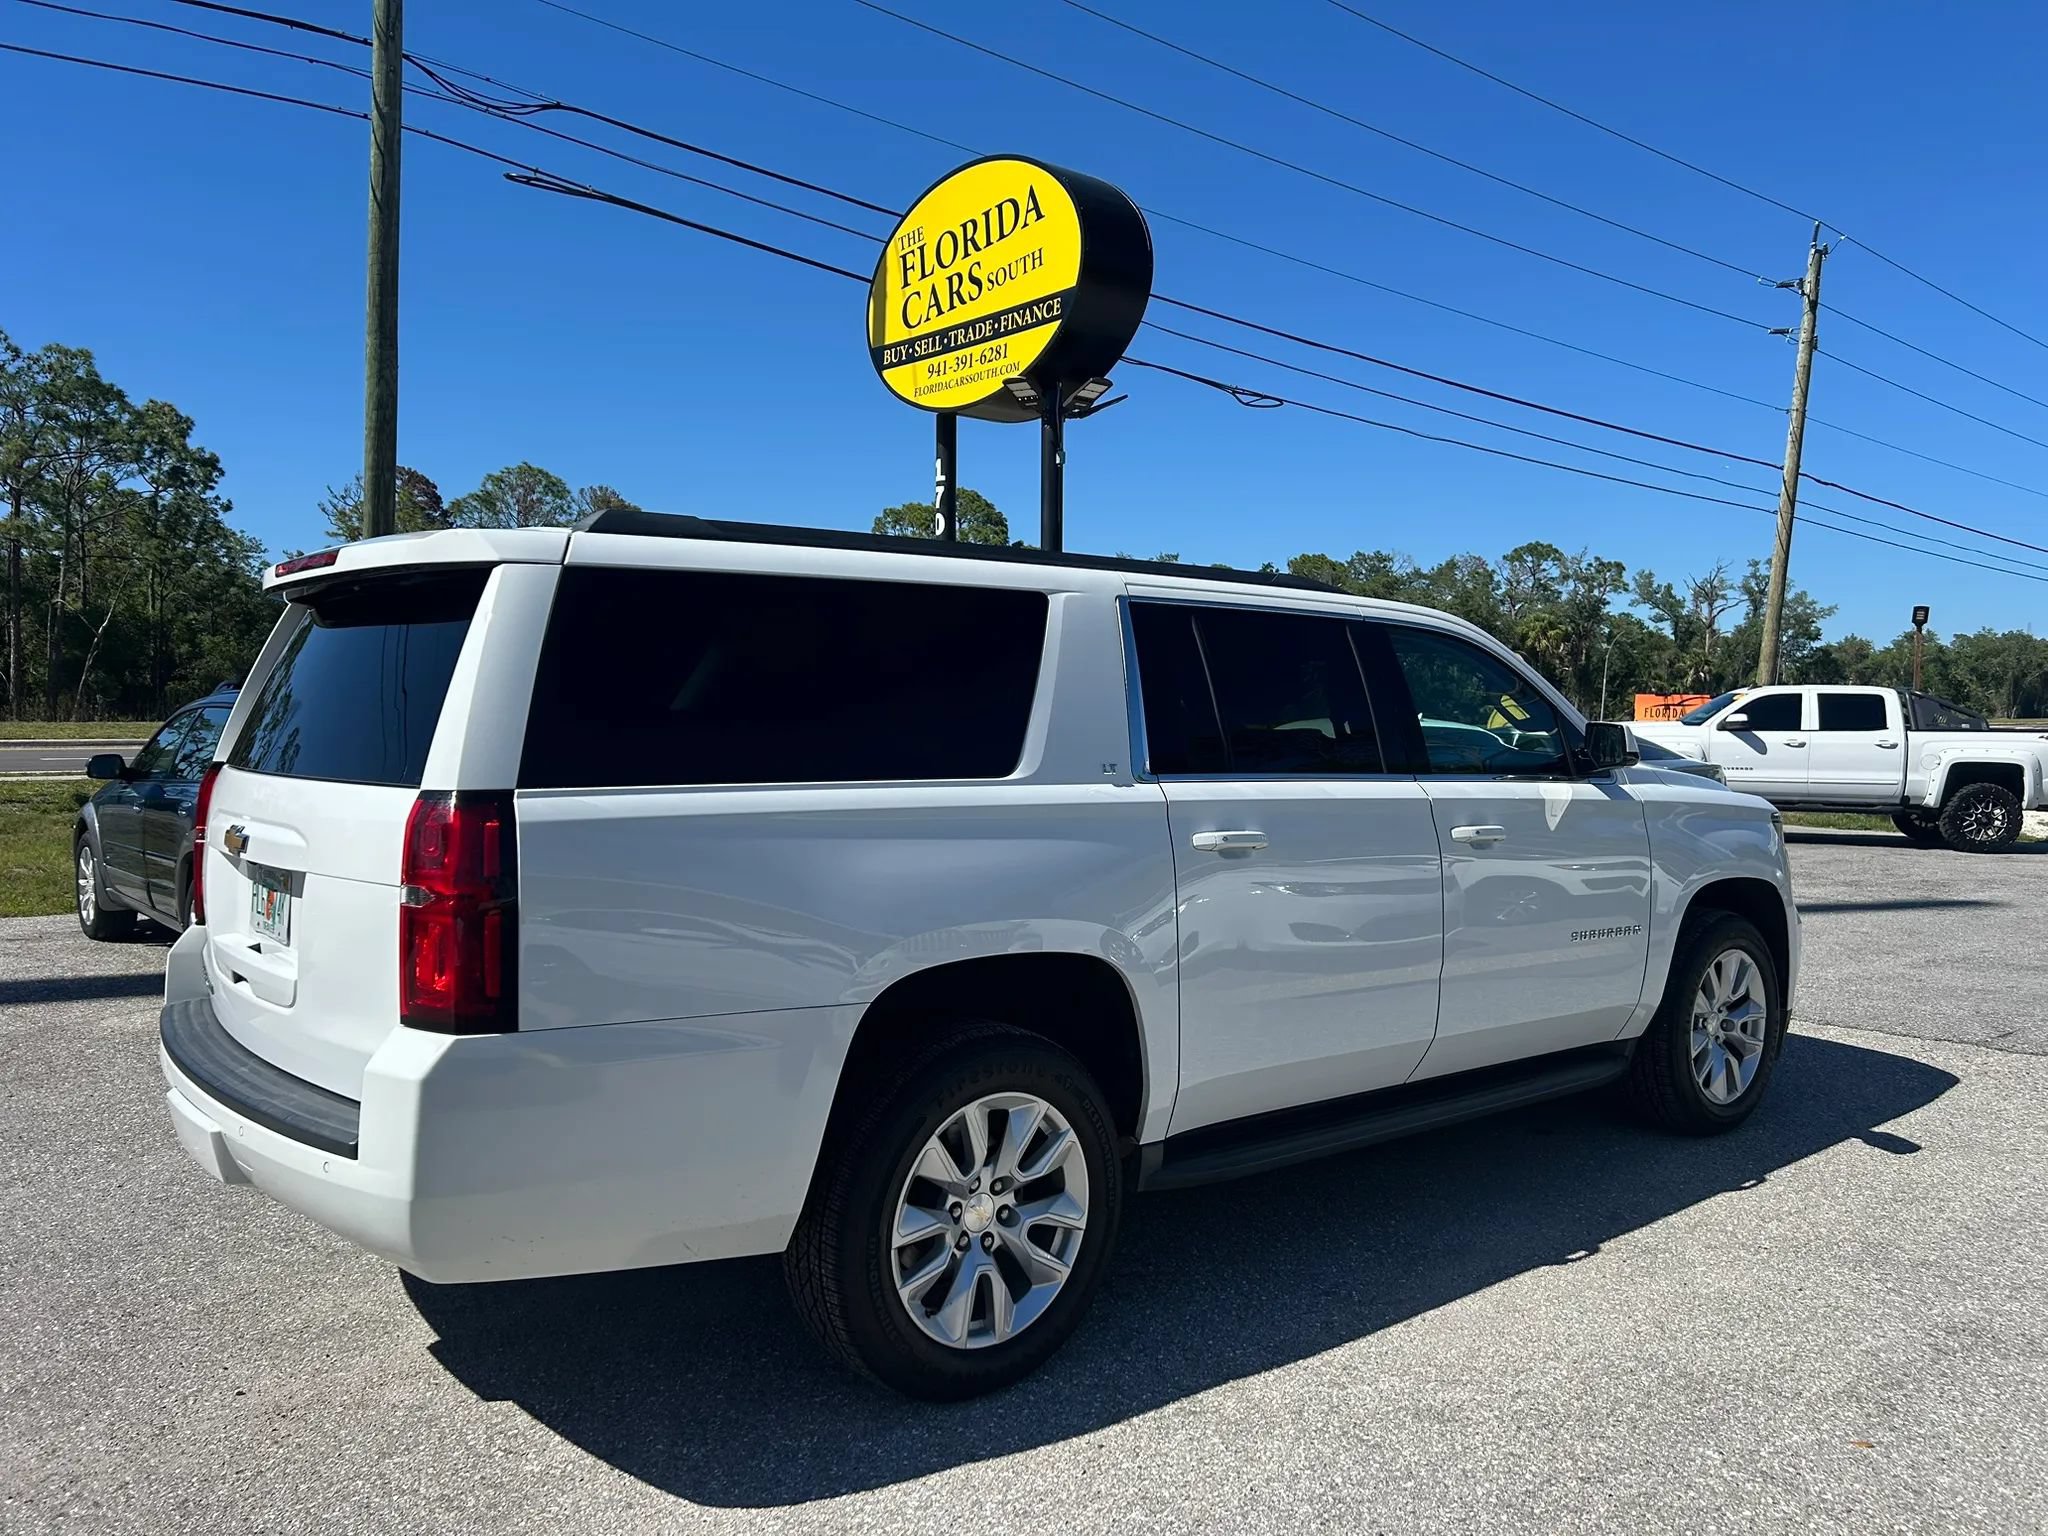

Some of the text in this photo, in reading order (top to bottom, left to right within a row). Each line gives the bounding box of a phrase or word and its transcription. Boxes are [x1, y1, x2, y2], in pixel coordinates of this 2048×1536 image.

[897, 226, 925, 251] THE
[899, 184, 1045, 290] FLORIDA
[901, 247, 1045, 329] CARS SOUTH
[883, 297, 1062, 365] BUY SELL TRADE FINANCE
[914, 361, 1021, 398] FLORIDACARSSOUTH.COM
[927, 343, 1009, 380] 941-391-6281
[1644, 707, 1686, 719] FLORIDA
[1103, 763, 1118, 775] LT
[1570, 924, 1642, 942] SUBURBAN
